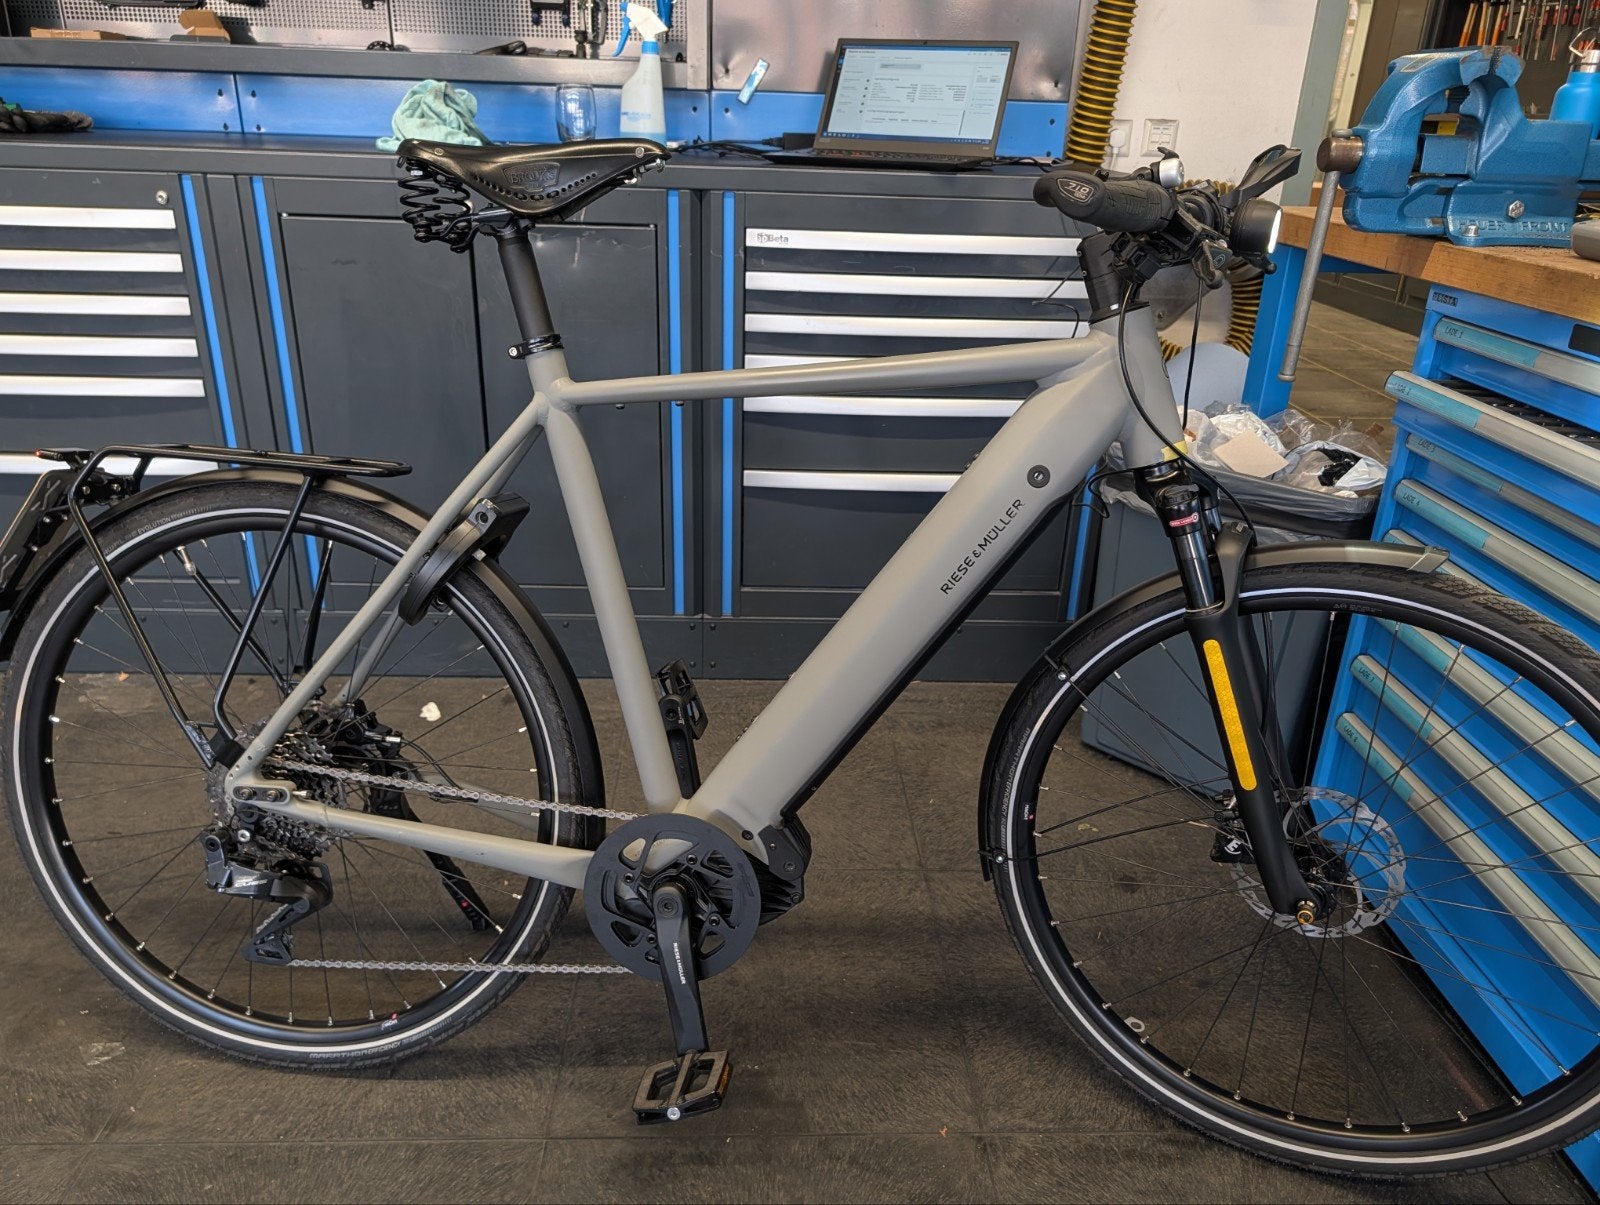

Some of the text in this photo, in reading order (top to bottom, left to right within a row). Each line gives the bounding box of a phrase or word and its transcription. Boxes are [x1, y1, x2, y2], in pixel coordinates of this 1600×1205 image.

[940, 556, 976, 595] RIESE
[977, 499, 1024, 552] MÜLLER
[309, 1049, 368, 1059] MARATHON
